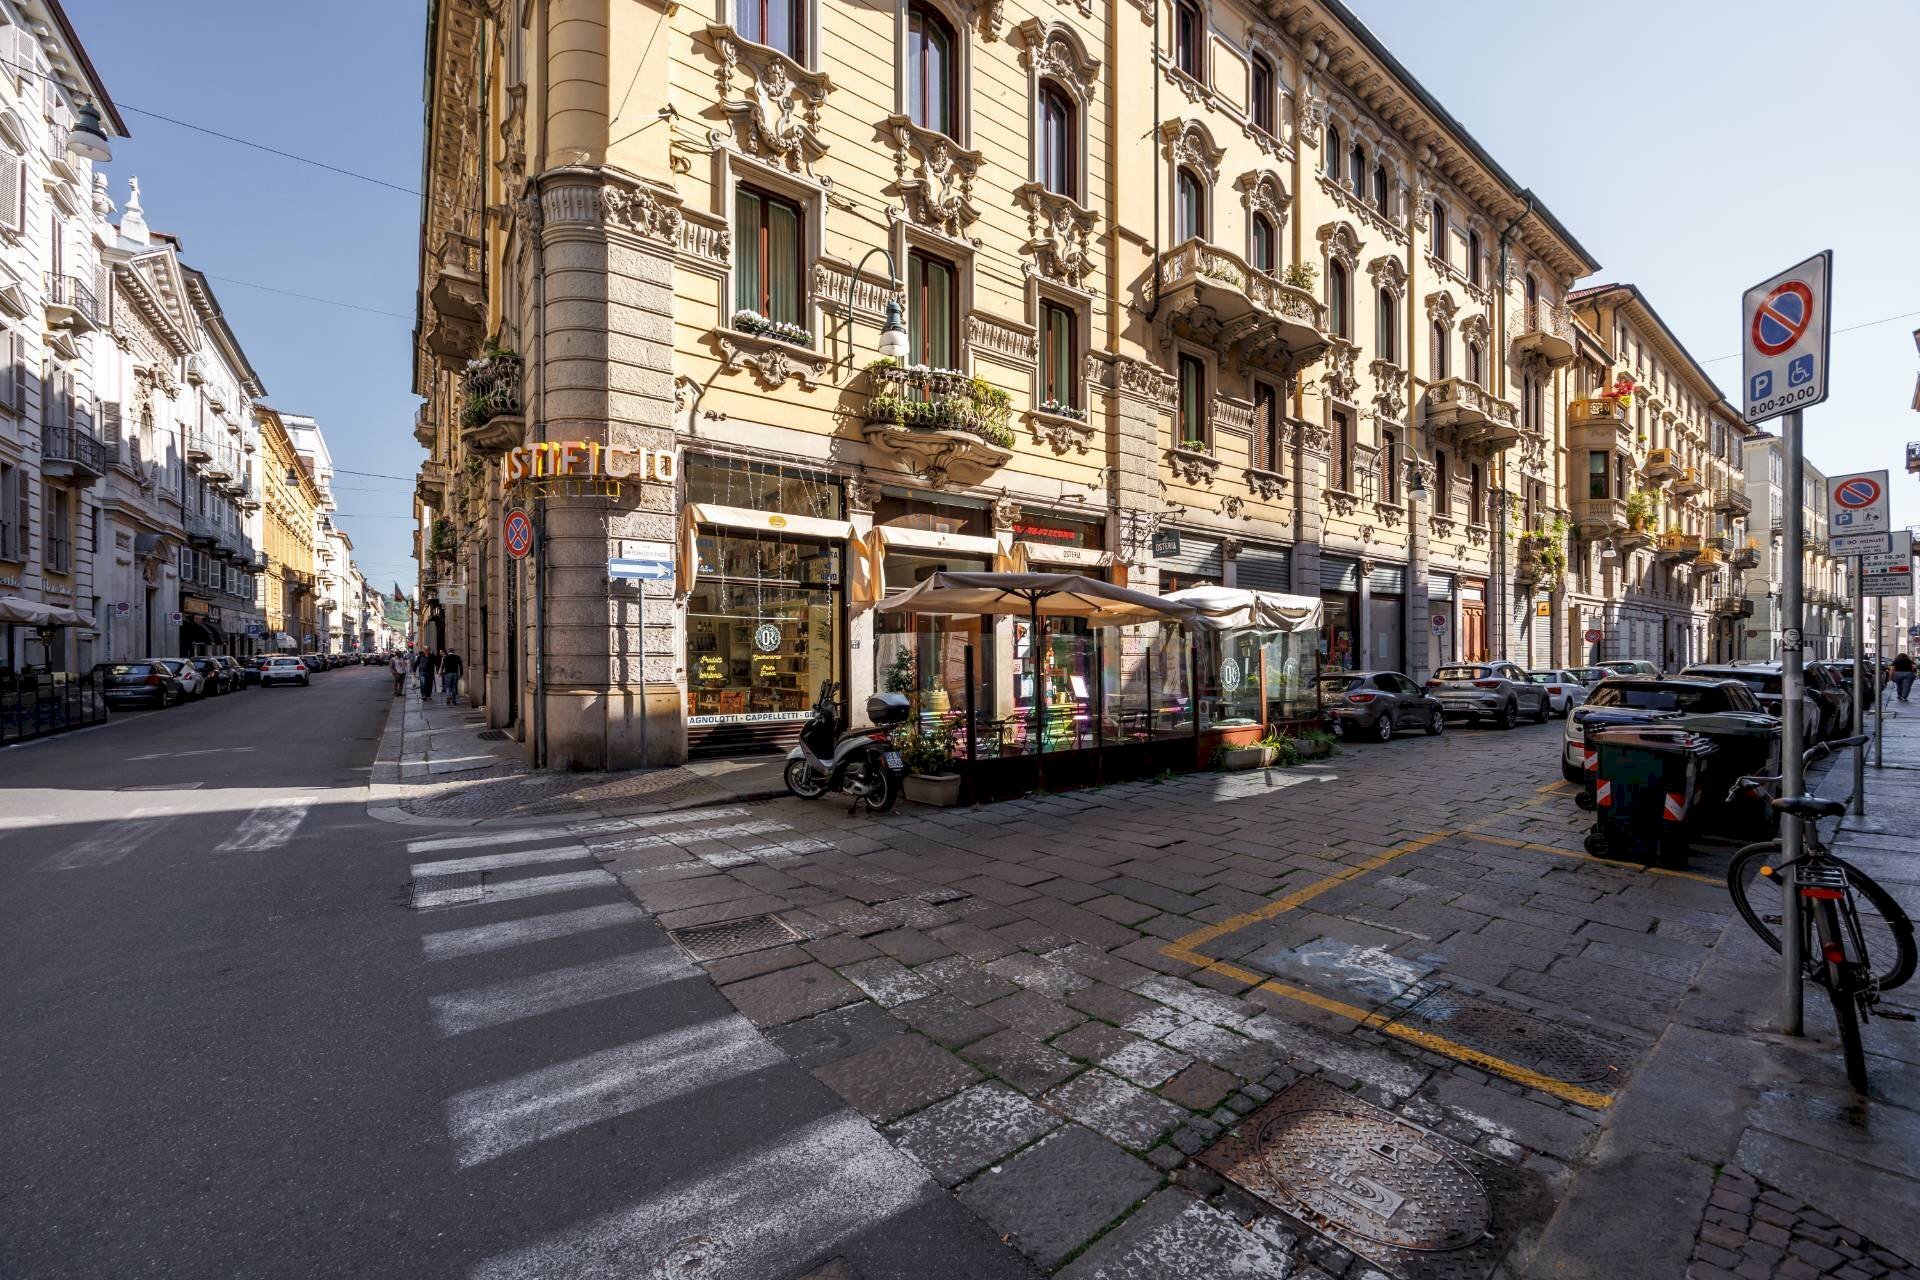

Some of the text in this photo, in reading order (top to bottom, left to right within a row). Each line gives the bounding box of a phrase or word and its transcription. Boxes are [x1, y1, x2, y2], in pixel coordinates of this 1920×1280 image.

[1755, 375, 1769, 398] P
[1750, 386, 1815, 417] 8.00-20.00
[1155, 541, 1177, 552] OSTERIA
[1063, 550, 1081, 559] OSTERIA
[689, 715, 738, 725] AGNOLOTTI
[745, 712, 798, 721] CAPPELLETTI
